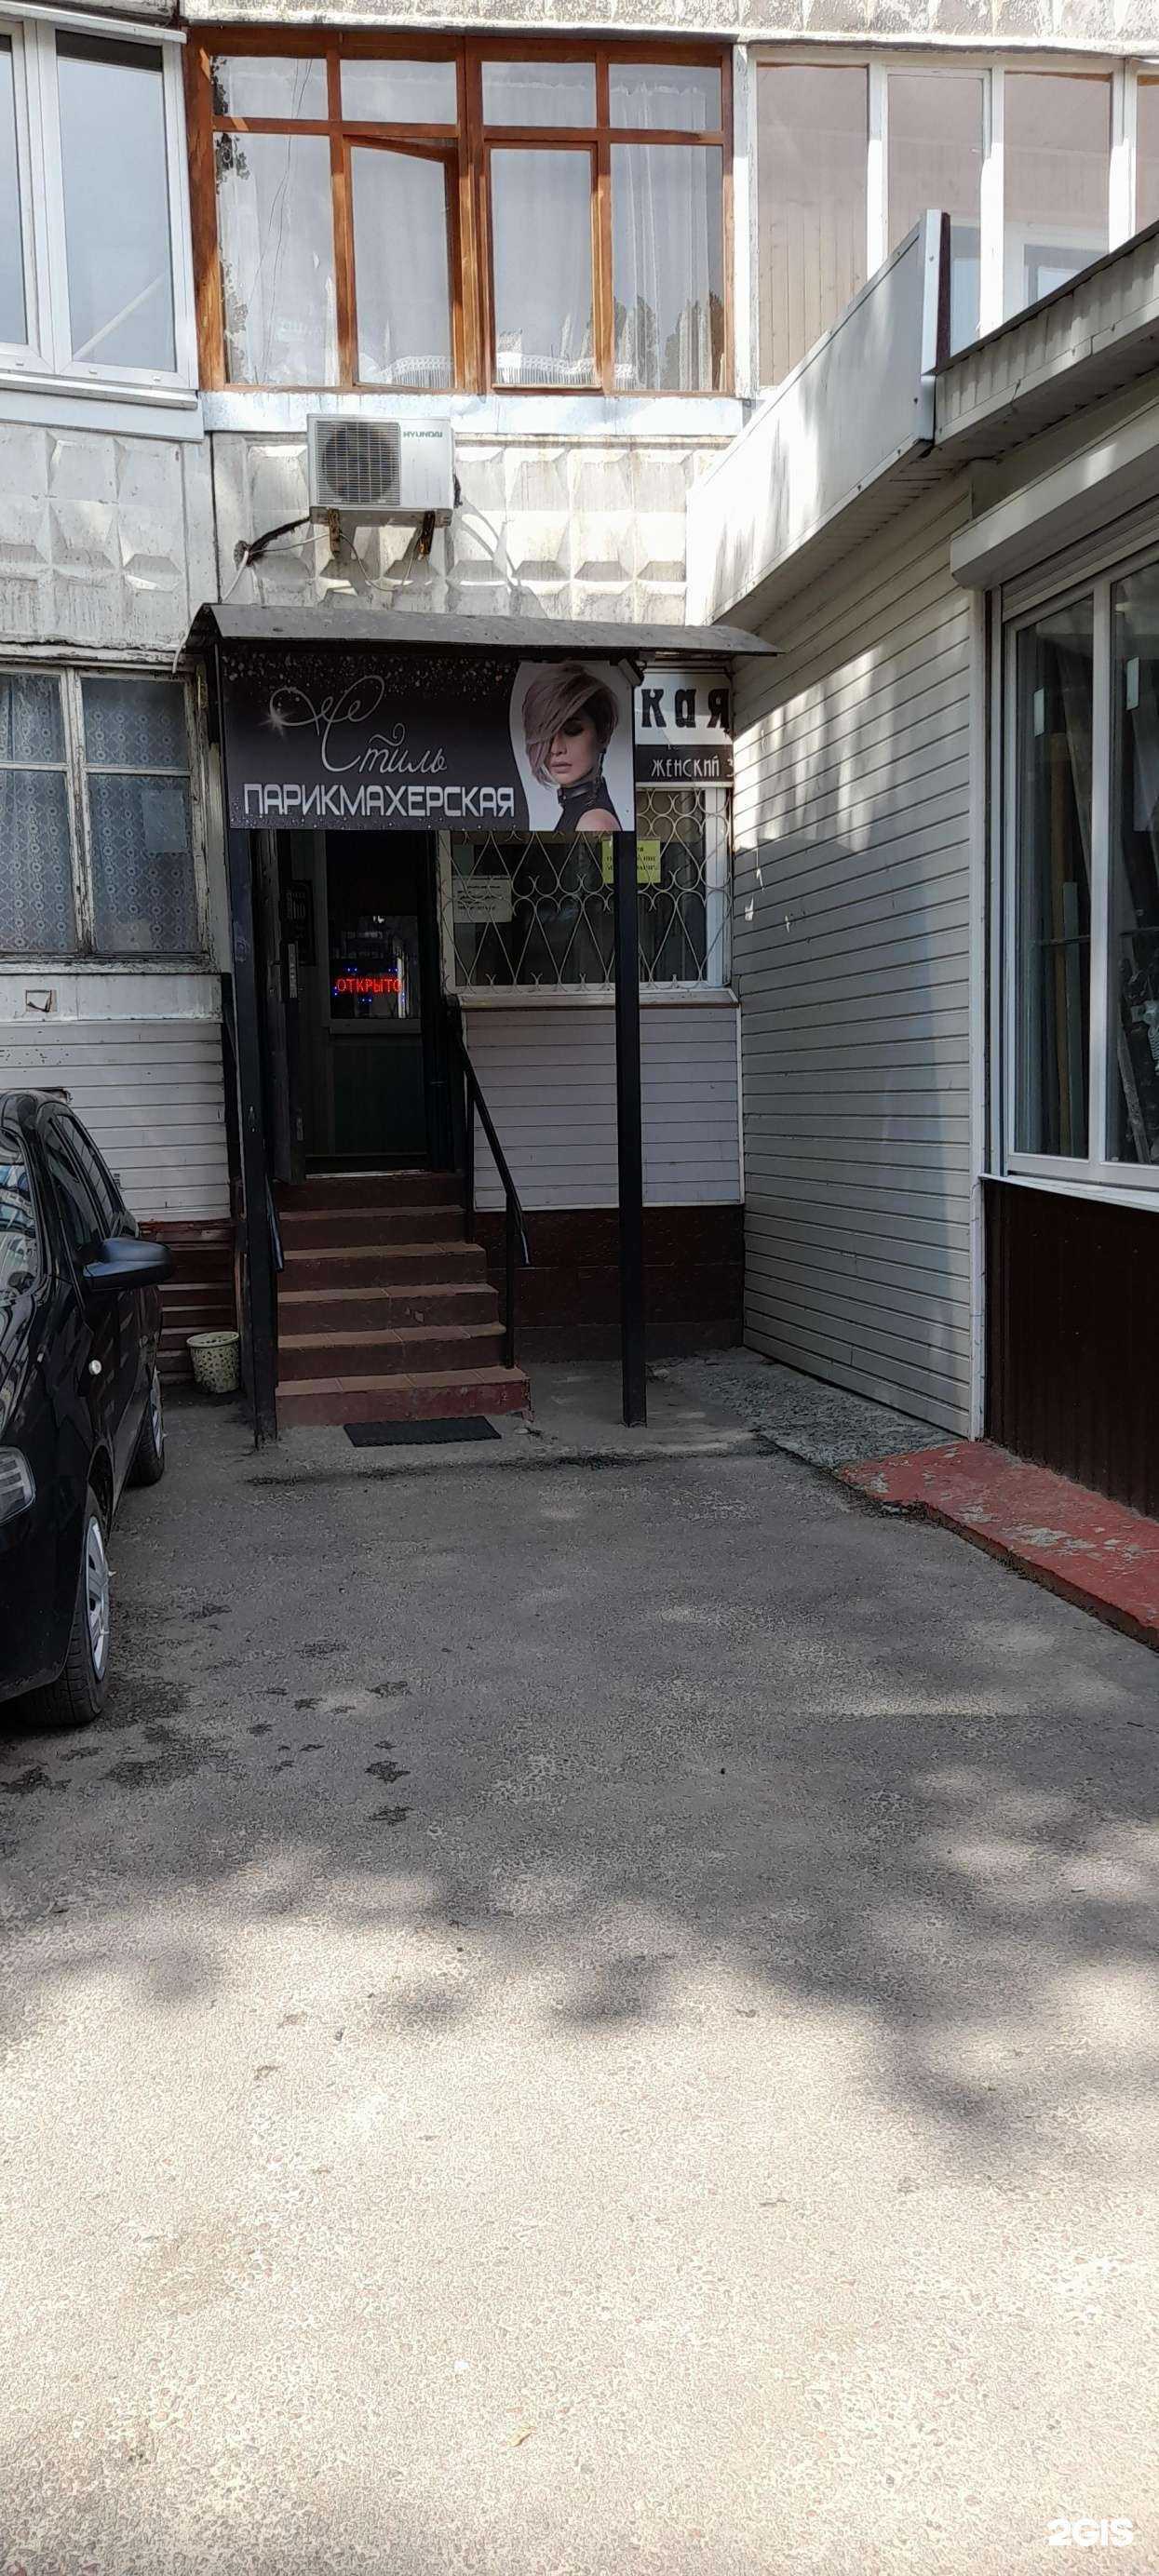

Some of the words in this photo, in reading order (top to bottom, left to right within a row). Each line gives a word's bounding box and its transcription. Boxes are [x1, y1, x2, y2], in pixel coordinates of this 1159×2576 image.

[270, 675, 448, 774] Стиль
[652, 755, 720, 778] ЖЕНСКИЙ
[243, 783, 514, 818] ПАРИКМАХЕРСКАЯ
[337, 978, 401, 993] ОТКРЫТО
